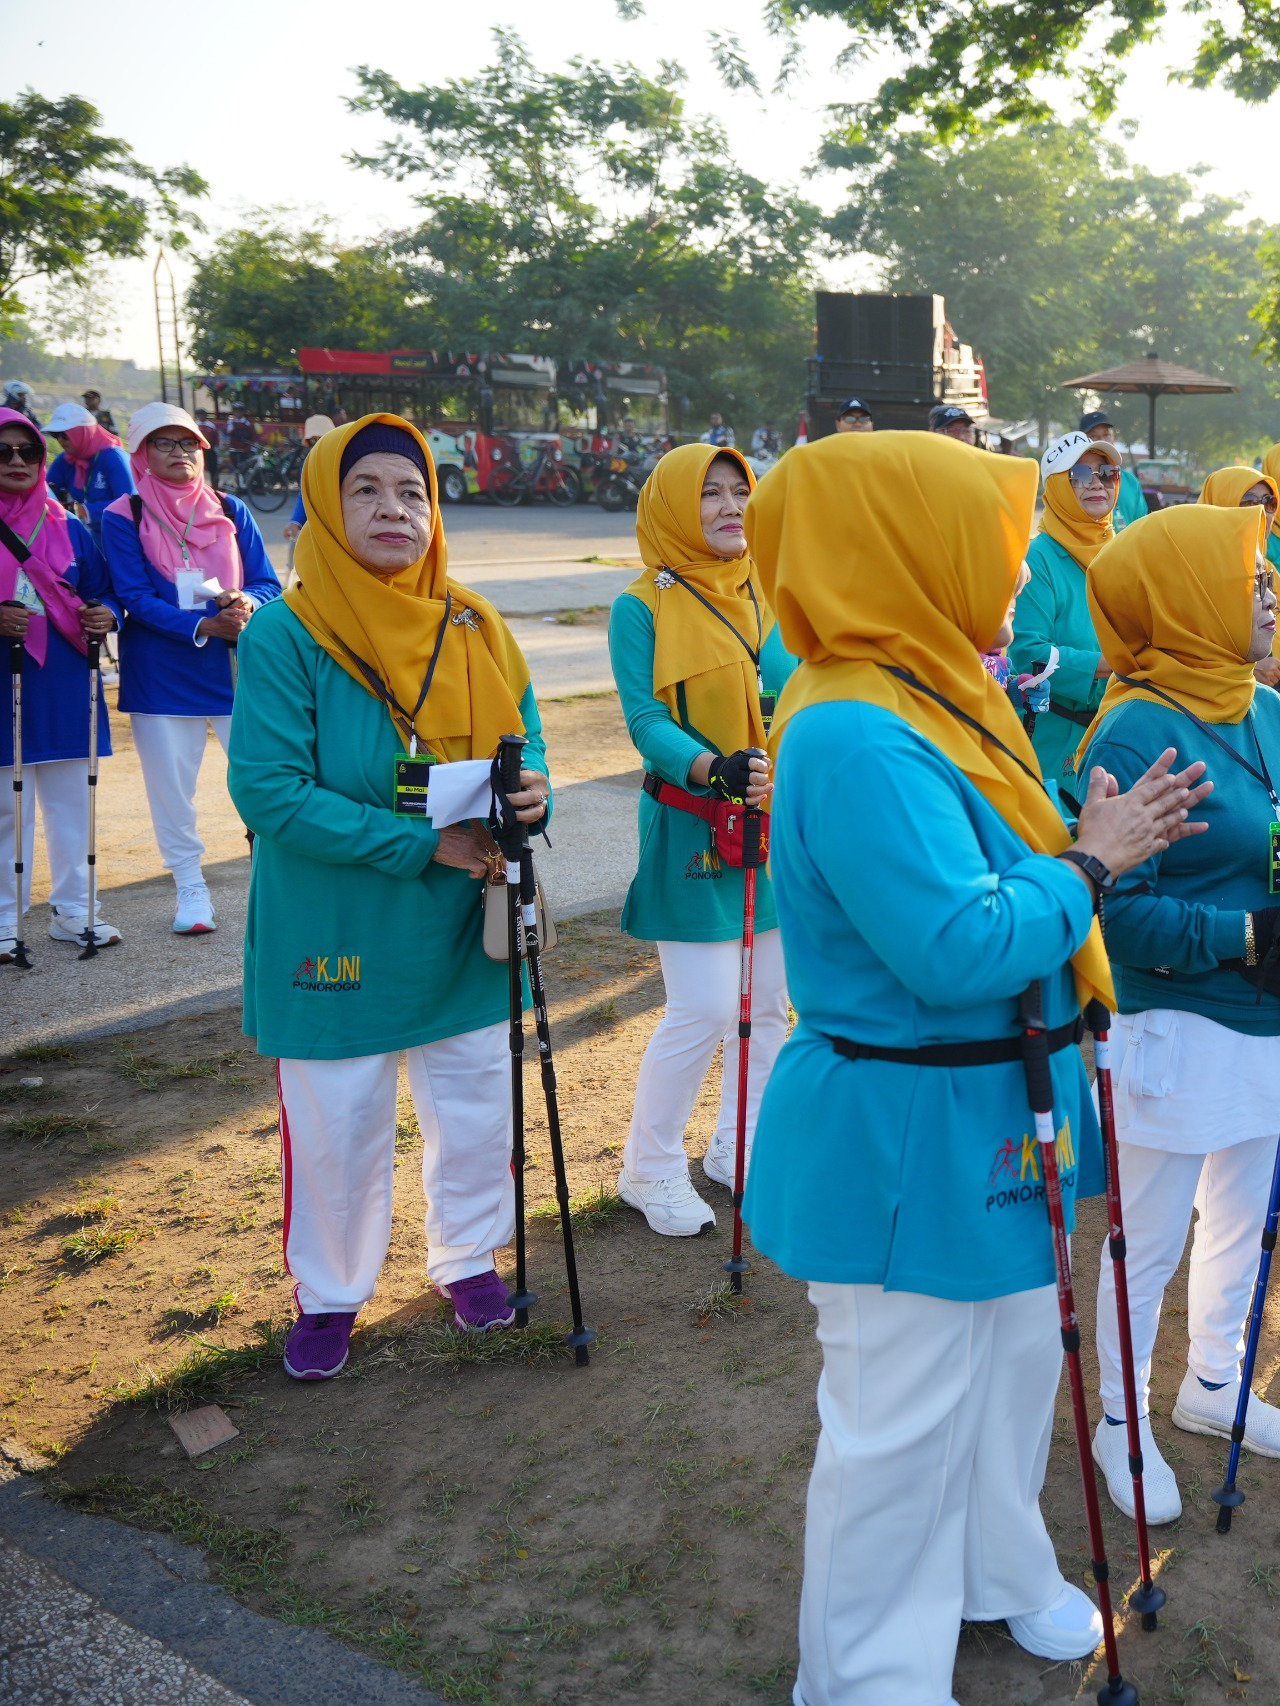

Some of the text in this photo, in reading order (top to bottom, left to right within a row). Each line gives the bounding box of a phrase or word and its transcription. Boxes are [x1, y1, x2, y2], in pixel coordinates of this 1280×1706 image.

[1046, 435, 1091, 464] CHA
[316, 955, 361, 982] KJNI
[292, 980, 362, 992] PONOROGO
